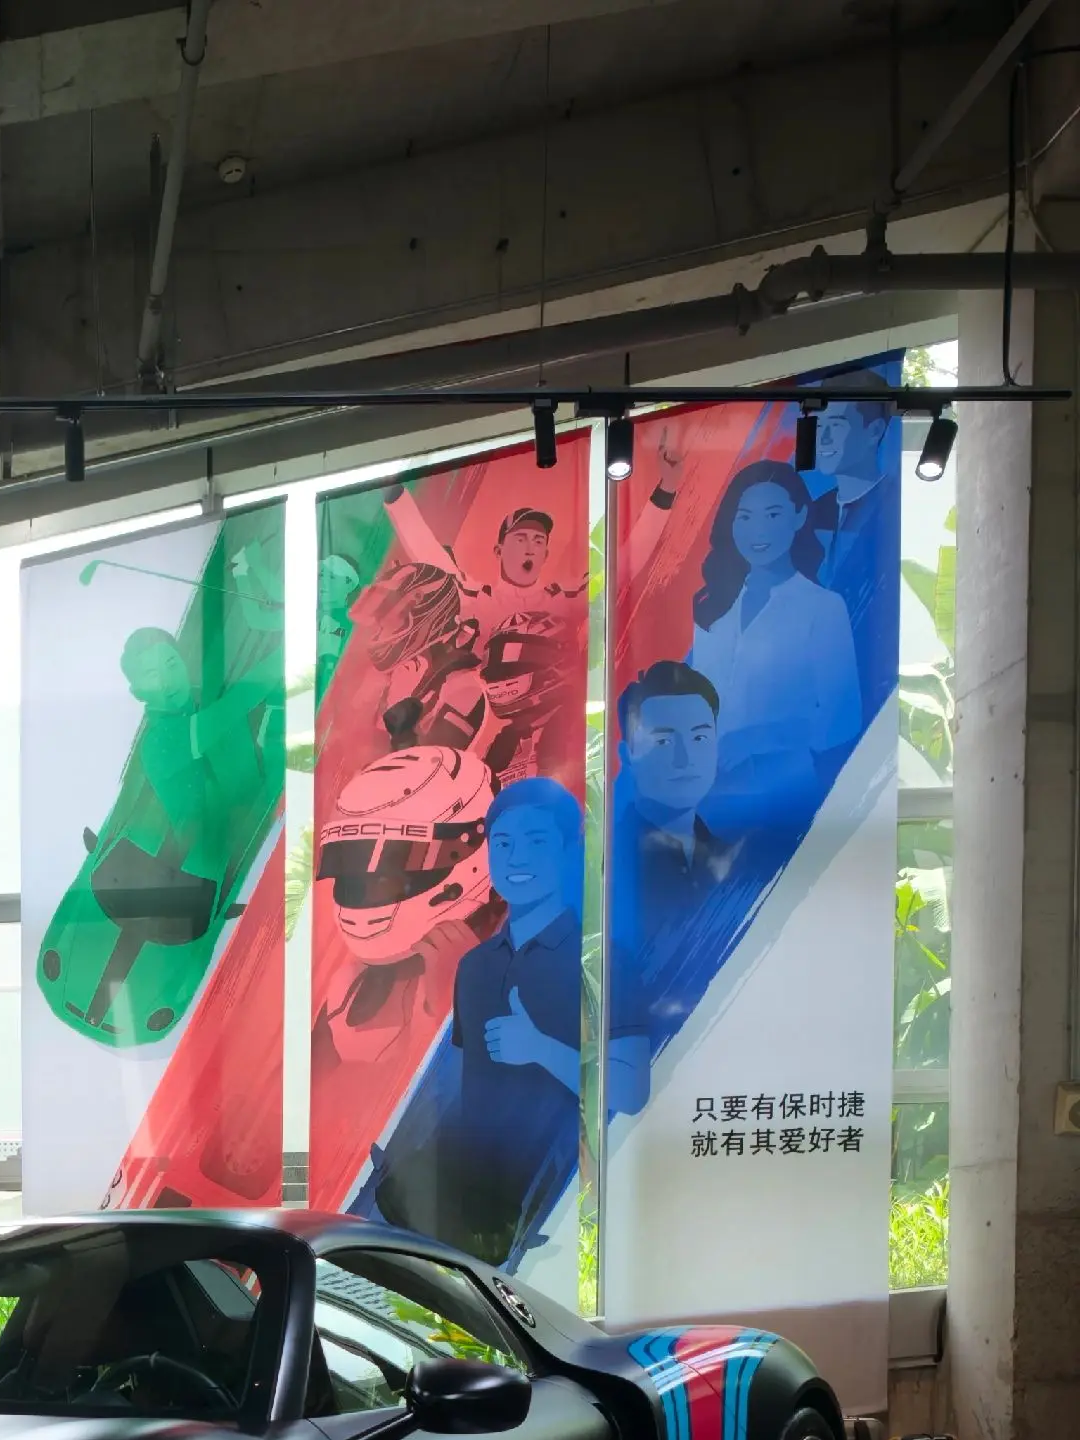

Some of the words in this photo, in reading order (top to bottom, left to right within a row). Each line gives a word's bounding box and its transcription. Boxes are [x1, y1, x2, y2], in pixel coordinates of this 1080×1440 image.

[692, 1090, 865, 1122] 只要有保时捷
[690, 1125, 864, 1158] 就有其爱好者
